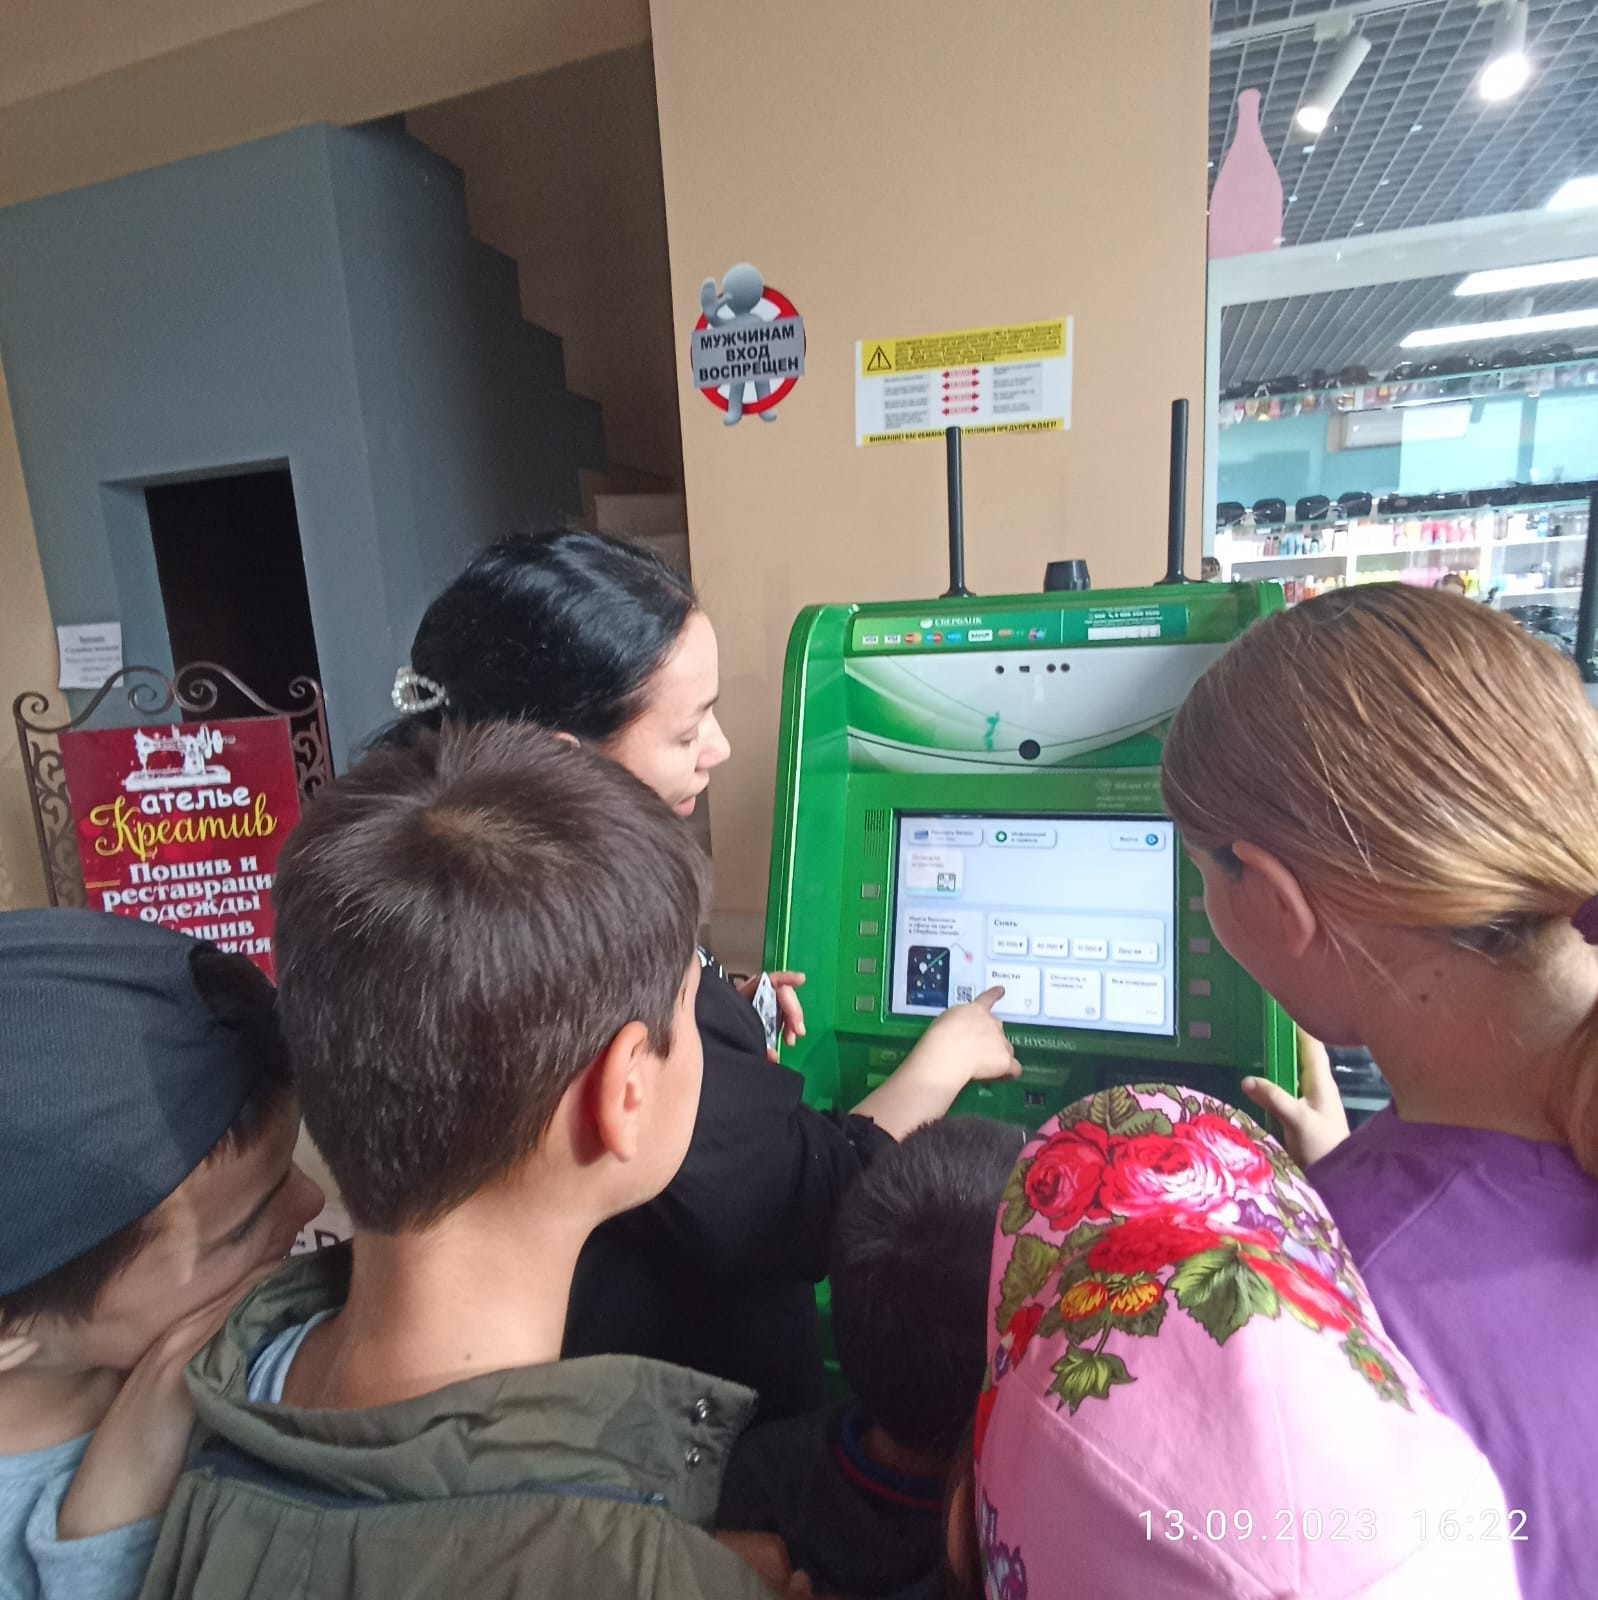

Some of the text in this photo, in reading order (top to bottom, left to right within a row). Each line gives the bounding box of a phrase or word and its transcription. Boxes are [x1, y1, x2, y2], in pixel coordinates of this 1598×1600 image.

[700, 324, 794, 350] МУЖЧИНАМ
[726, 344, 771, 362] ВХОД
[699, 356, 799, 381] ВОСПРЕЩЕН
[140, 786, 250, 815] ателье
[89, 791, 277, 862] Креатив
[129, 855, 258, 884] Пошив и
[102, 873, 276, 912] реставраци
[140, 895, 261, 924] одежды
[1024, 1036, 1077, 1050] HYOSUNG
